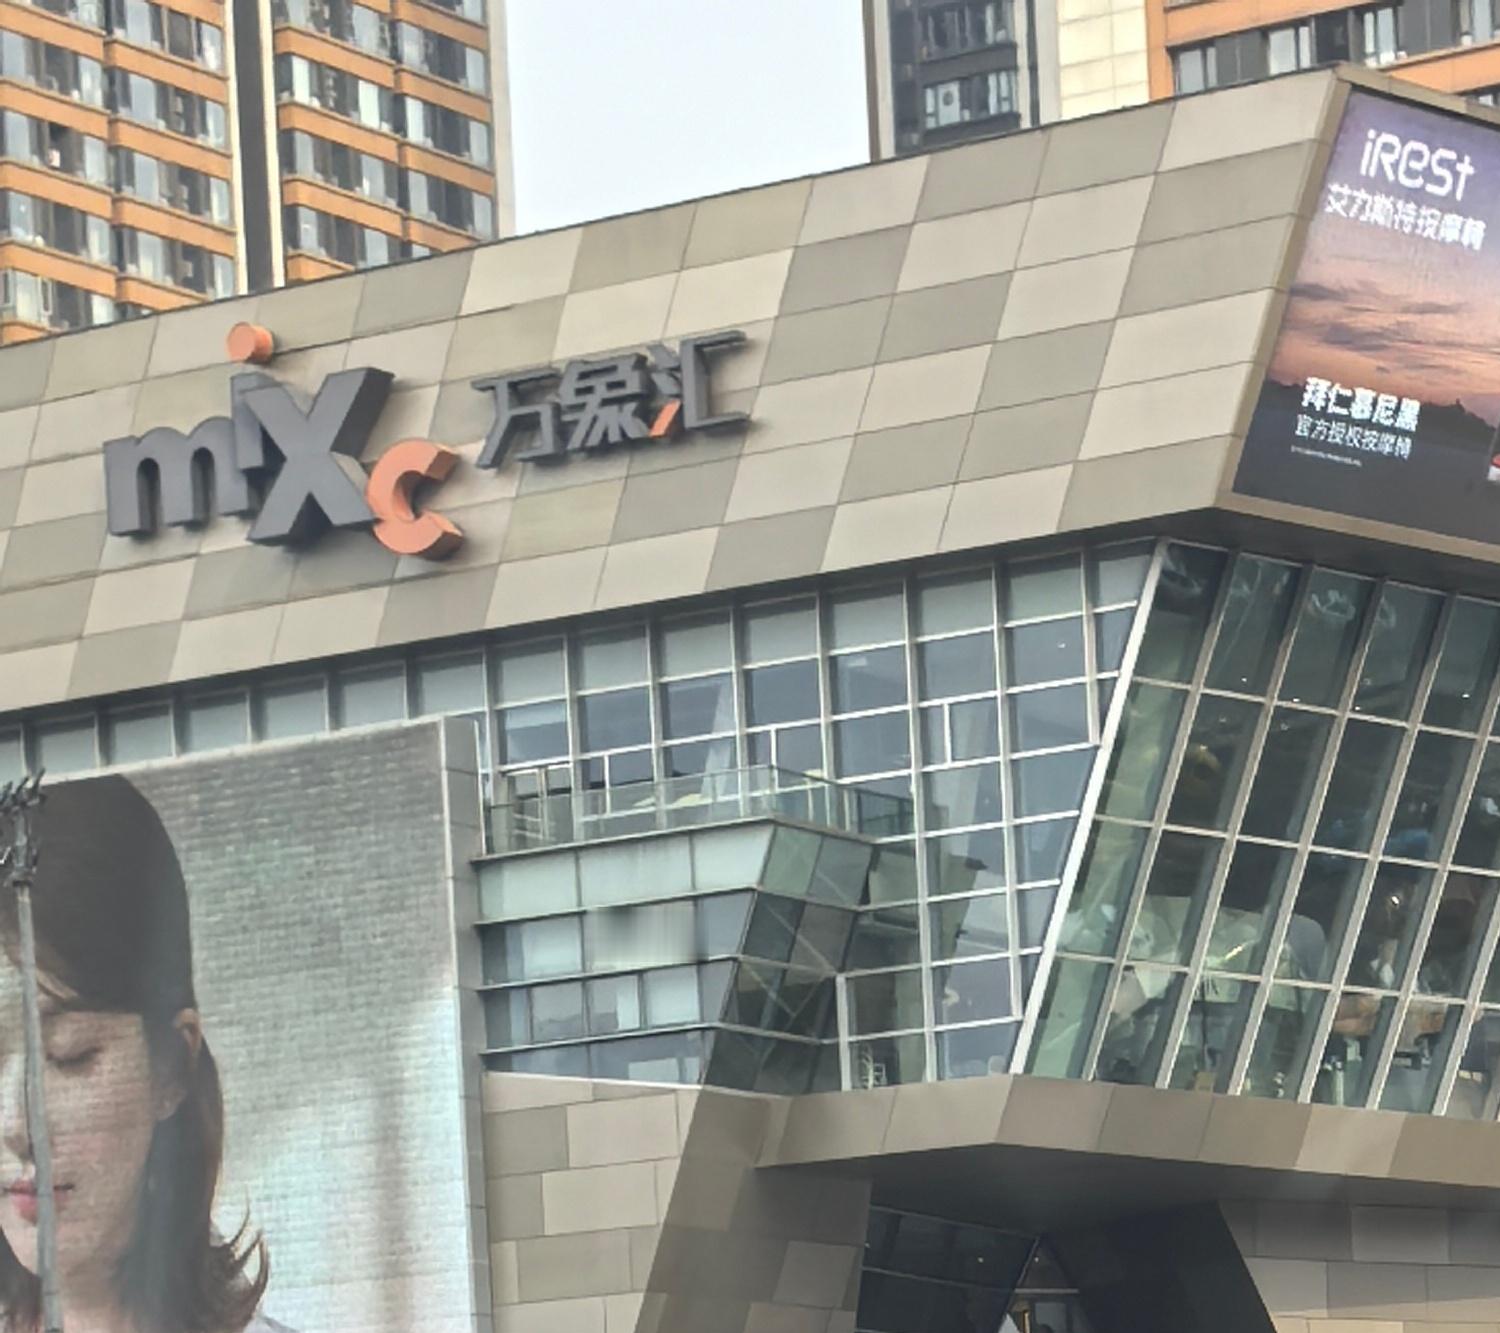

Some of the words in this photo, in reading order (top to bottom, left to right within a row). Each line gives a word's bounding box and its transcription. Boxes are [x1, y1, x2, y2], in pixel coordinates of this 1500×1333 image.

[470, 330, 756, 470] 万象汇
[1302, 376, 1421, 432] 拜仁慕尼黑
